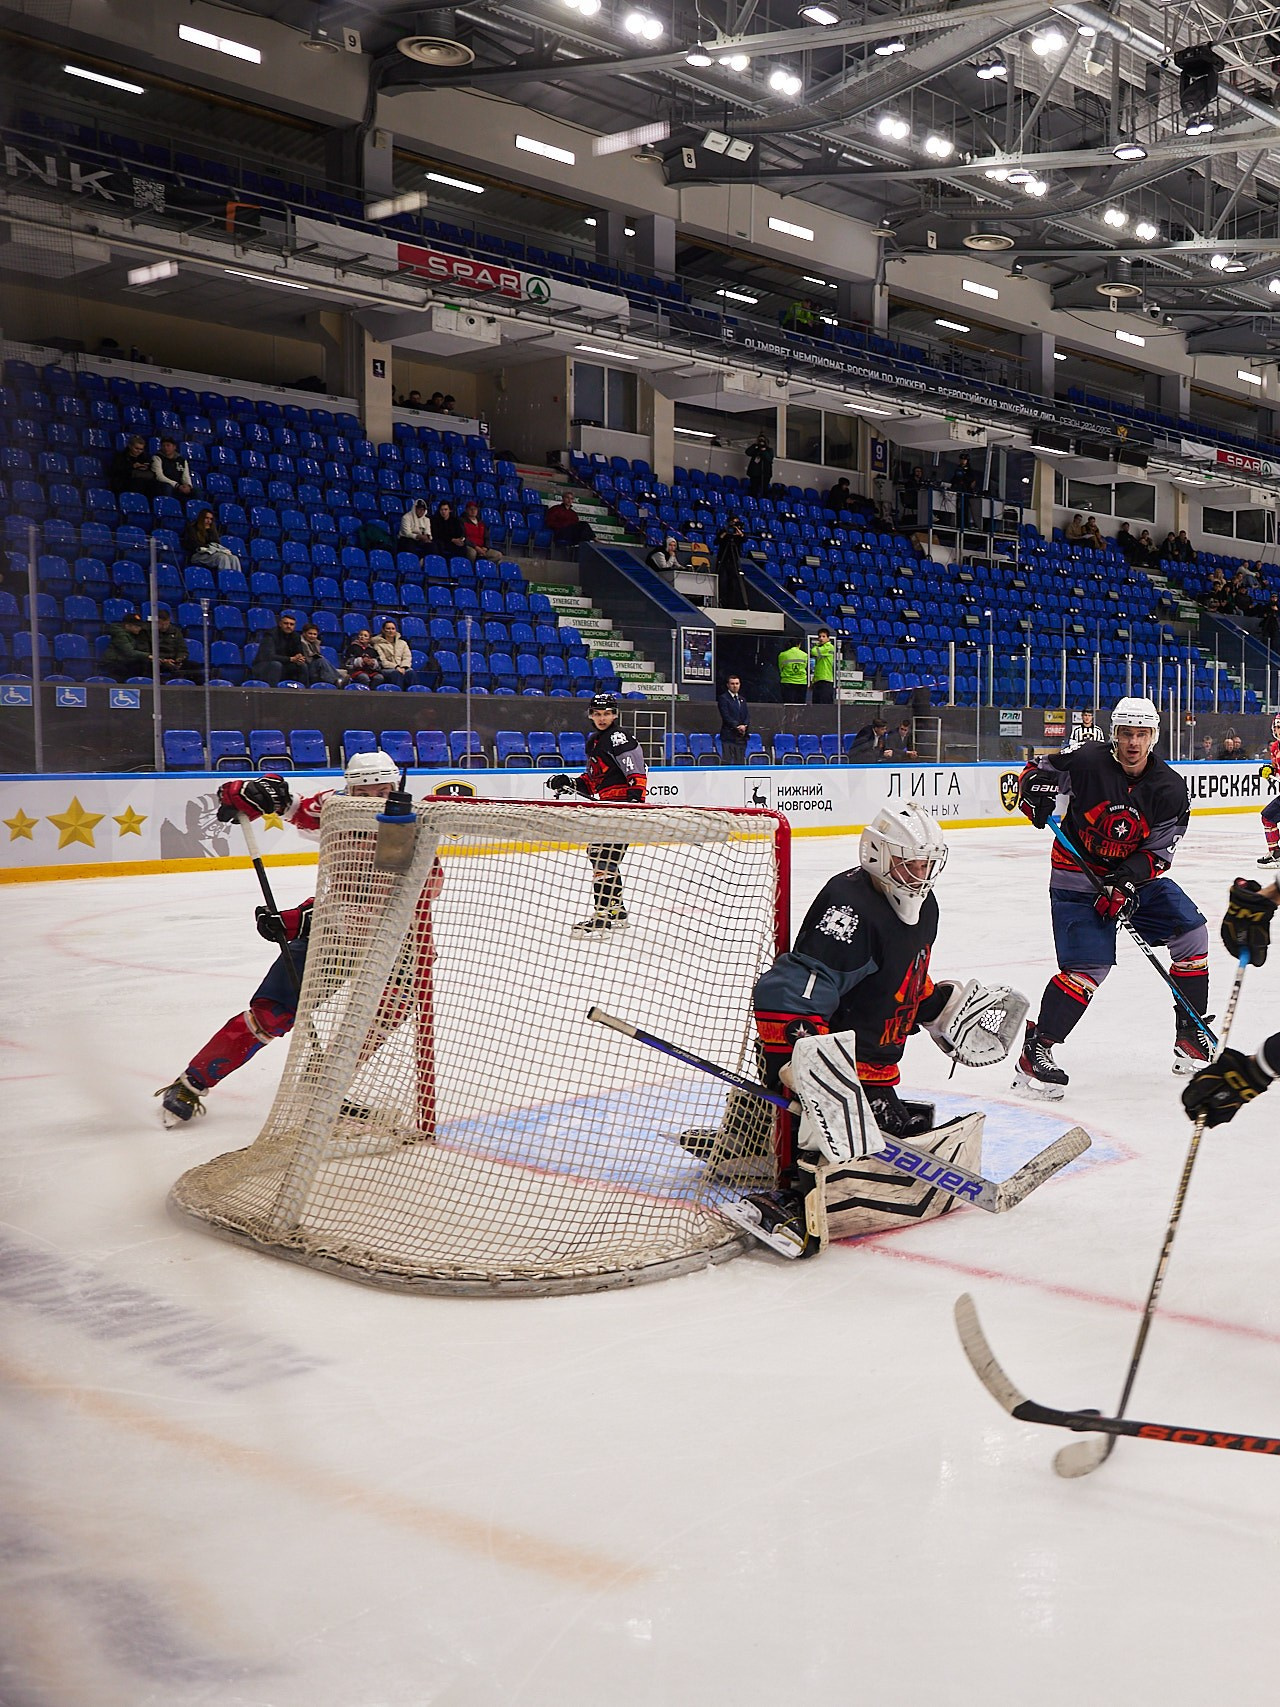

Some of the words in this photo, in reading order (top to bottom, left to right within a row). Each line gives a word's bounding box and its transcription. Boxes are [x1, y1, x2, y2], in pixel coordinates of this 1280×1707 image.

[347, 34, 356, 48] 9
[686, 153, 693, 165] 8
[929, 235, 935, 245] 7
[428, 256, 519, 293] SPAR
[374, 362, 382, 373] 1
[793, 350, 846, 371] ЧЕМПИОНАТ
[847, 363, 880, 380] РОССИИ
[882, 372, 893, 384] ПО
[895, 375, 926, 391] ХОККЕЮ
[937, 385, 998, 408] ВСЕРОССИЙСКАЯ
[480, 423, 489, 433] 5
[875, 444, 883, 460] 9
[1227, 455, 1261, 472] SPAR
[552, 597, 580, 606] SYNERGETIC
[572, 619, 600, 628] SYNERGETIC
[593, 640, 620, 648] SYNERGETIC
[615, 662, 643, 670] SYNERGETIC
[637, 684, 665, 692] SYNERGETIC
[1001, 712, 1021, 720] PARI
[777, 782, 823, 796] НИЖНИЙ
[887, 771, 961, 798] ЛИГА
[777, 800, 833, 812] НОВГОРОД
[720, 1070, 745, 1084] MACH
[873, 1141, 984, 1202] BAUER
